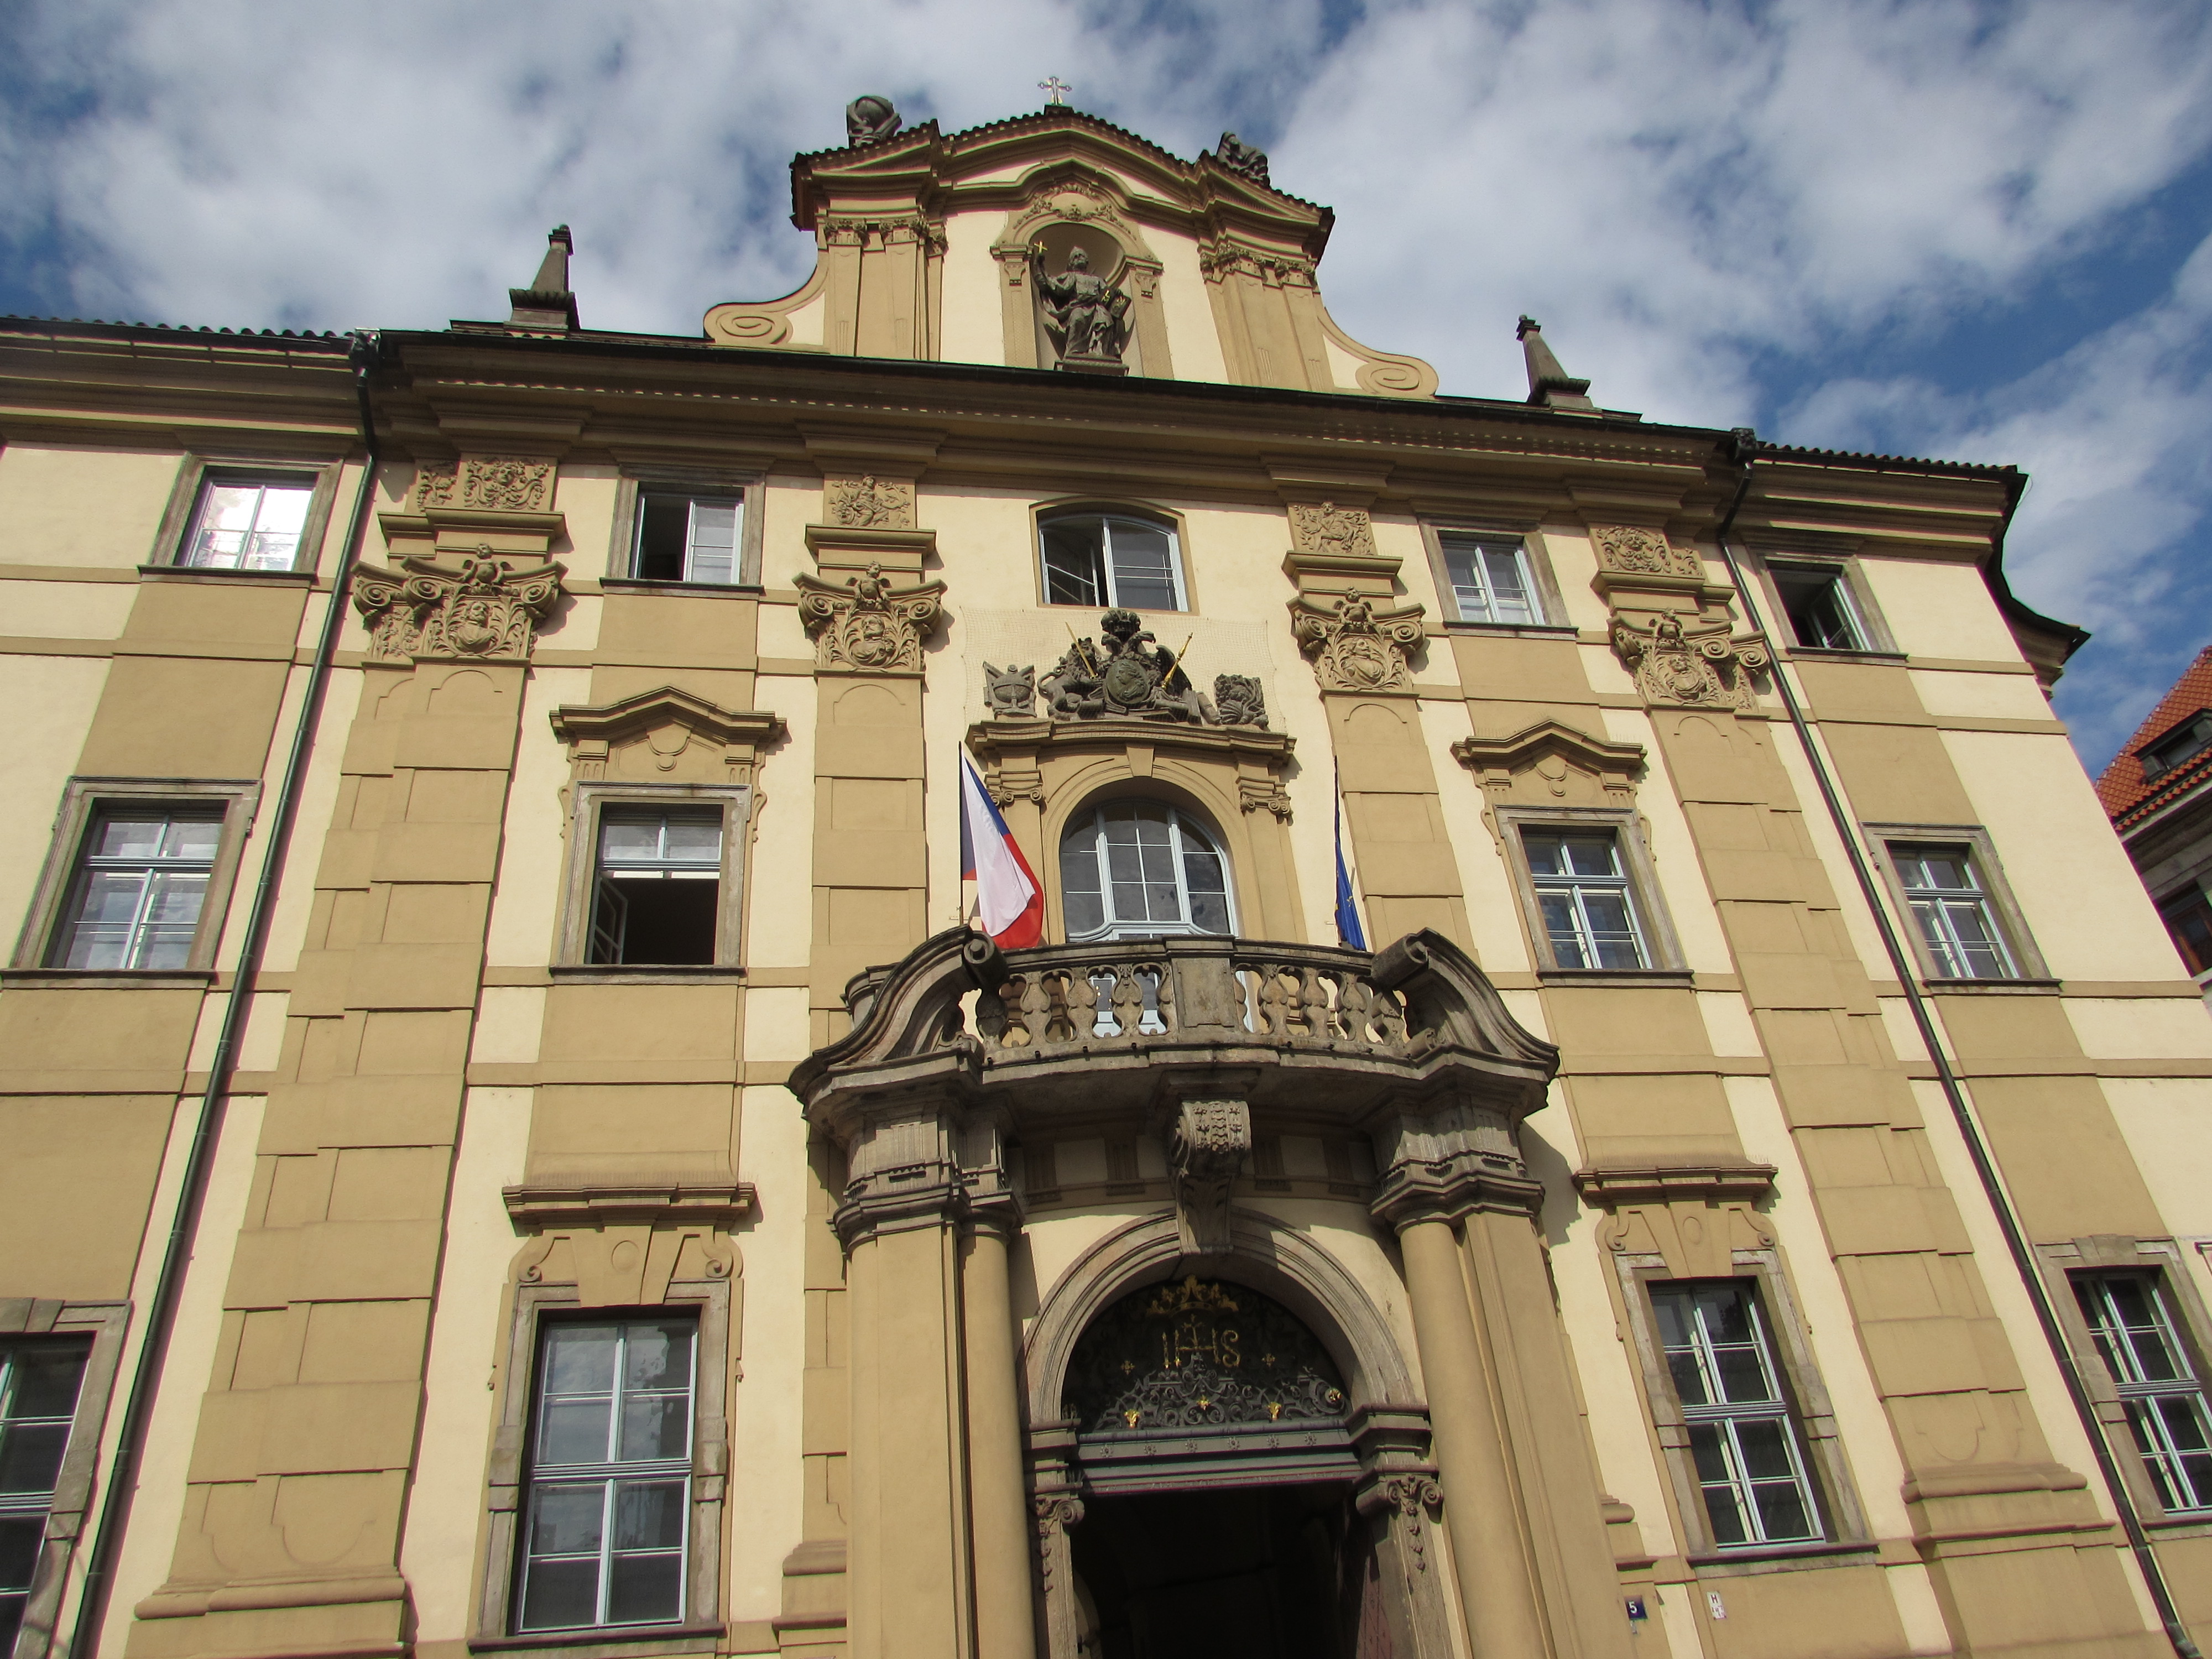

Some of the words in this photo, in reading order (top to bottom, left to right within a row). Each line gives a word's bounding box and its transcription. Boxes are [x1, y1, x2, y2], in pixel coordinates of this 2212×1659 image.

[1161, 1328, 1241, 1369] IHS
[1710, 1594, 1718, 1604] H
[1628, 1600, 1637, 1614] 5
